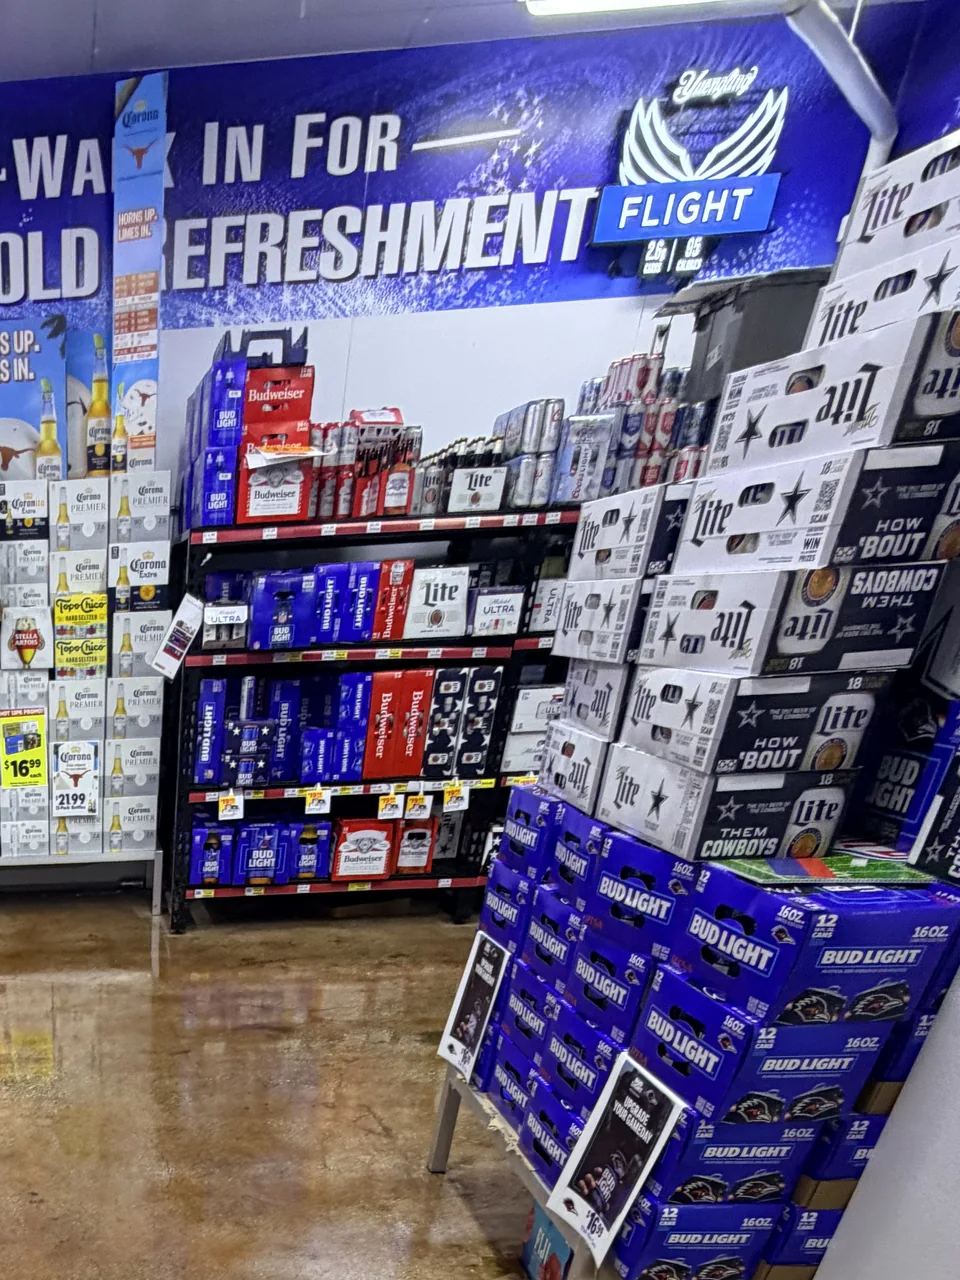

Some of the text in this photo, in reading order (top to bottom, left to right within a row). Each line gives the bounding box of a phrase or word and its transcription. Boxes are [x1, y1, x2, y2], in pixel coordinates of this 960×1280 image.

[203, 122, 265, 186] IN
[291, 112, 402, 180] FOR
[619, 188, 754, 229] FLIGHT
[857, 182, 915, 244] Lite
[161, 188, 598, 292] EFRESHMENT
[14, 330, 41, 354] UP.
[13, 361, 34, 382] IN.
[248, 388, 305, 402] Budweiser
[815, 362, 884, 426] Lite
[219, 410, 236, 420] BUD
[467, 473, 492, 491] Lite
[132, 495, 169, 506] PREMIER
[209, 492, 227, 501] BUD
[253, 489, 296, 500] Budweiser
[70, 502, 107, 513] PREMIER
[690, 498, 733, 548] Lite
[809, 513, 829, 525] SCAN
[874, 517, 924, 533] HOW
[803, 536, 821, 550] WIN
[857, 532, 926, 559] 'BOUT
[70, 572, 106, 582] PREMIER
[850, 568, 939, 595] COWBOYS
[422, 581, 459, 607] Lite
[56, 599, 107, 612] Topo Chico
[542, 587, 558, 625] ULTRA
[861, 594, 915, 609] THEM
[382, 585, 399, 639] Budweiser
[482, 603, 515, 615] ULTRA
[210, 614, 242, 624] ULTRA
[14, 632, 40, 640] STELLA
[14, 638, 39, 647] ARTOIS
[56, 641, 107, 655] Topo Chico
[846, 676, 863, 691] 18
[69, 700, 103, 709] PREMIER
[127, 697, 161, 707] PREMIER
[375, 692, 393, 759] Budweiser
[404, 690, 424, 757] Budweiser
[815, 705, 869, 737] Lite
[753, 735, 800, 749] HOW
[60, 752, 91, 764] Corona
[739, 749, 803, 771] 'BOUT
[819, 773, 834, 786] 18
[792, 798, 841, 827] Lite
[720, 826, 769, 838] THEM
[252, 849, 274, 859] BUD
[699, 837, 779, 859] COWBOYS
[248, 857, 277, 868] LIGHT
[343, 855, 384, 863] Budweiser
[777, 905, 806, 925] 16OZ.
[816, 914, 839, 928] 12
[811, 930, 833, 939] CANS
[912, 925, 949, 939] 16OZ.
[690, 914, 774, 973] BUD LIGHT
[821, 949, 922, 965] BUD LIGHT
[723, 1014, 746, 1037] 16OZ.
[758, 1027, 778, 1040] 12
[646, 1009, 720, 1075] BUD LIGHT
[754, 1041, 774, 1050] CANS
[844, 1036, 880, 1049] 16OZ.
[762, 1056, 854, 1072] BUD LIGHT
[623, 1095, 651, 1126] UPGRADE
[611, 1100, 654, 1145] YOUR GAMEDAY
[851, 1120, 870, 1132] 12
[781, 1128, 815, 1139] 16OZ.
[661, 1207, 679, 1218] 12
[800, 1211, 818, 1222] 12
[741, 1217, 773, 1228] 16OZ.
